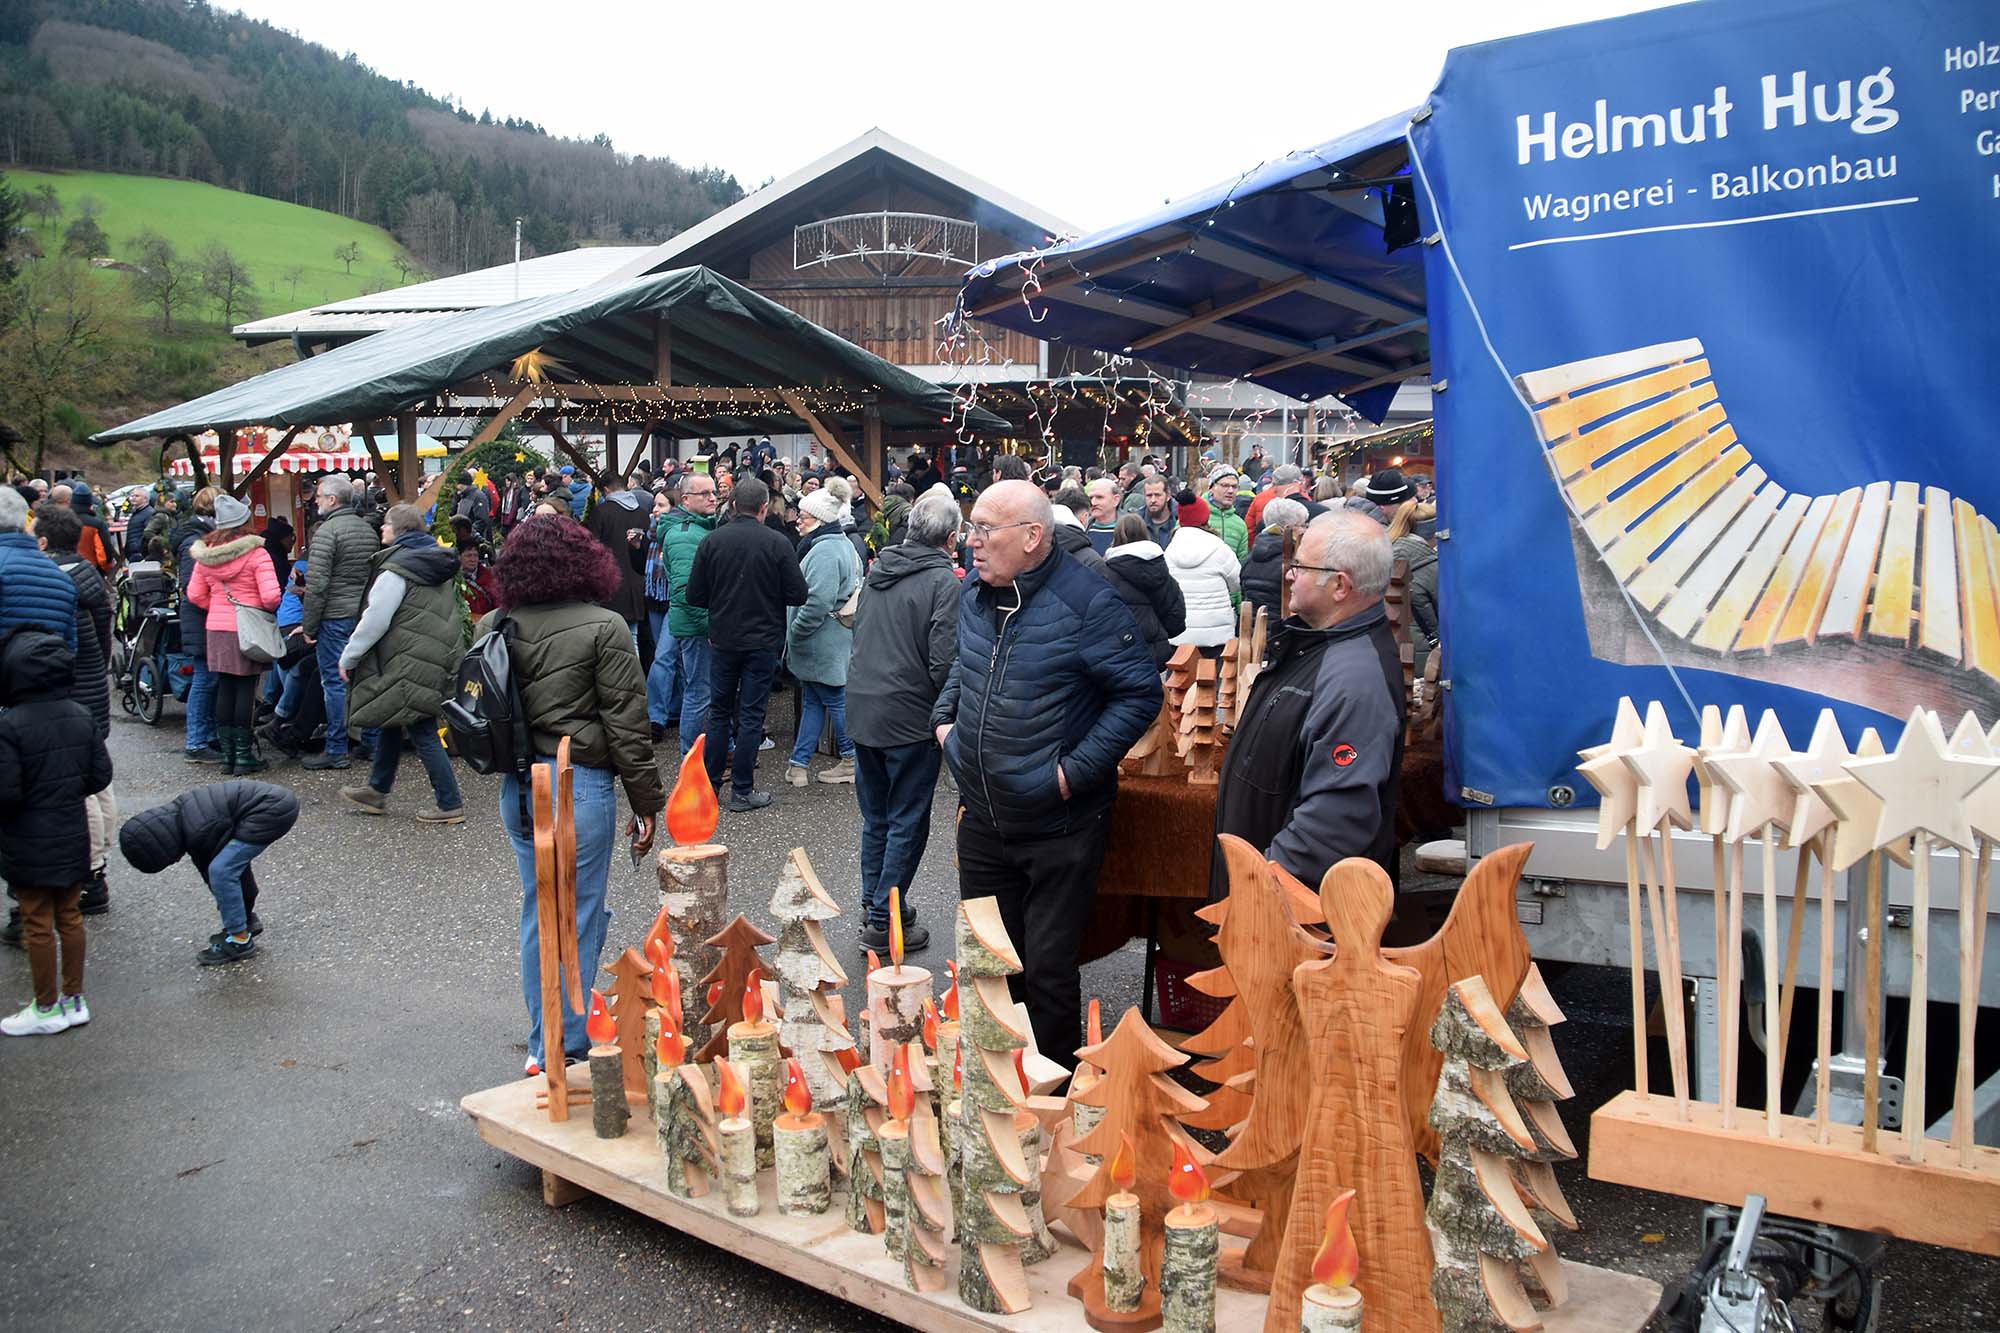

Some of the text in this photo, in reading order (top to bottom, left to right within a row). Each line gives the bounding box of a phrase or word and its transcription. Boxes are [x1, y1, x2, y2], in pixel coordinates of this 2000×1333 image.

[1944, 41, 2000, 72] Holz
[1515, 66, 1900, 165] Helmut Hug
[1961, 88, 2000, 113] Per
[1523, 178, 1674, 222] Wagnerei
[1711, 154, 1897, 200] Balkonbau
